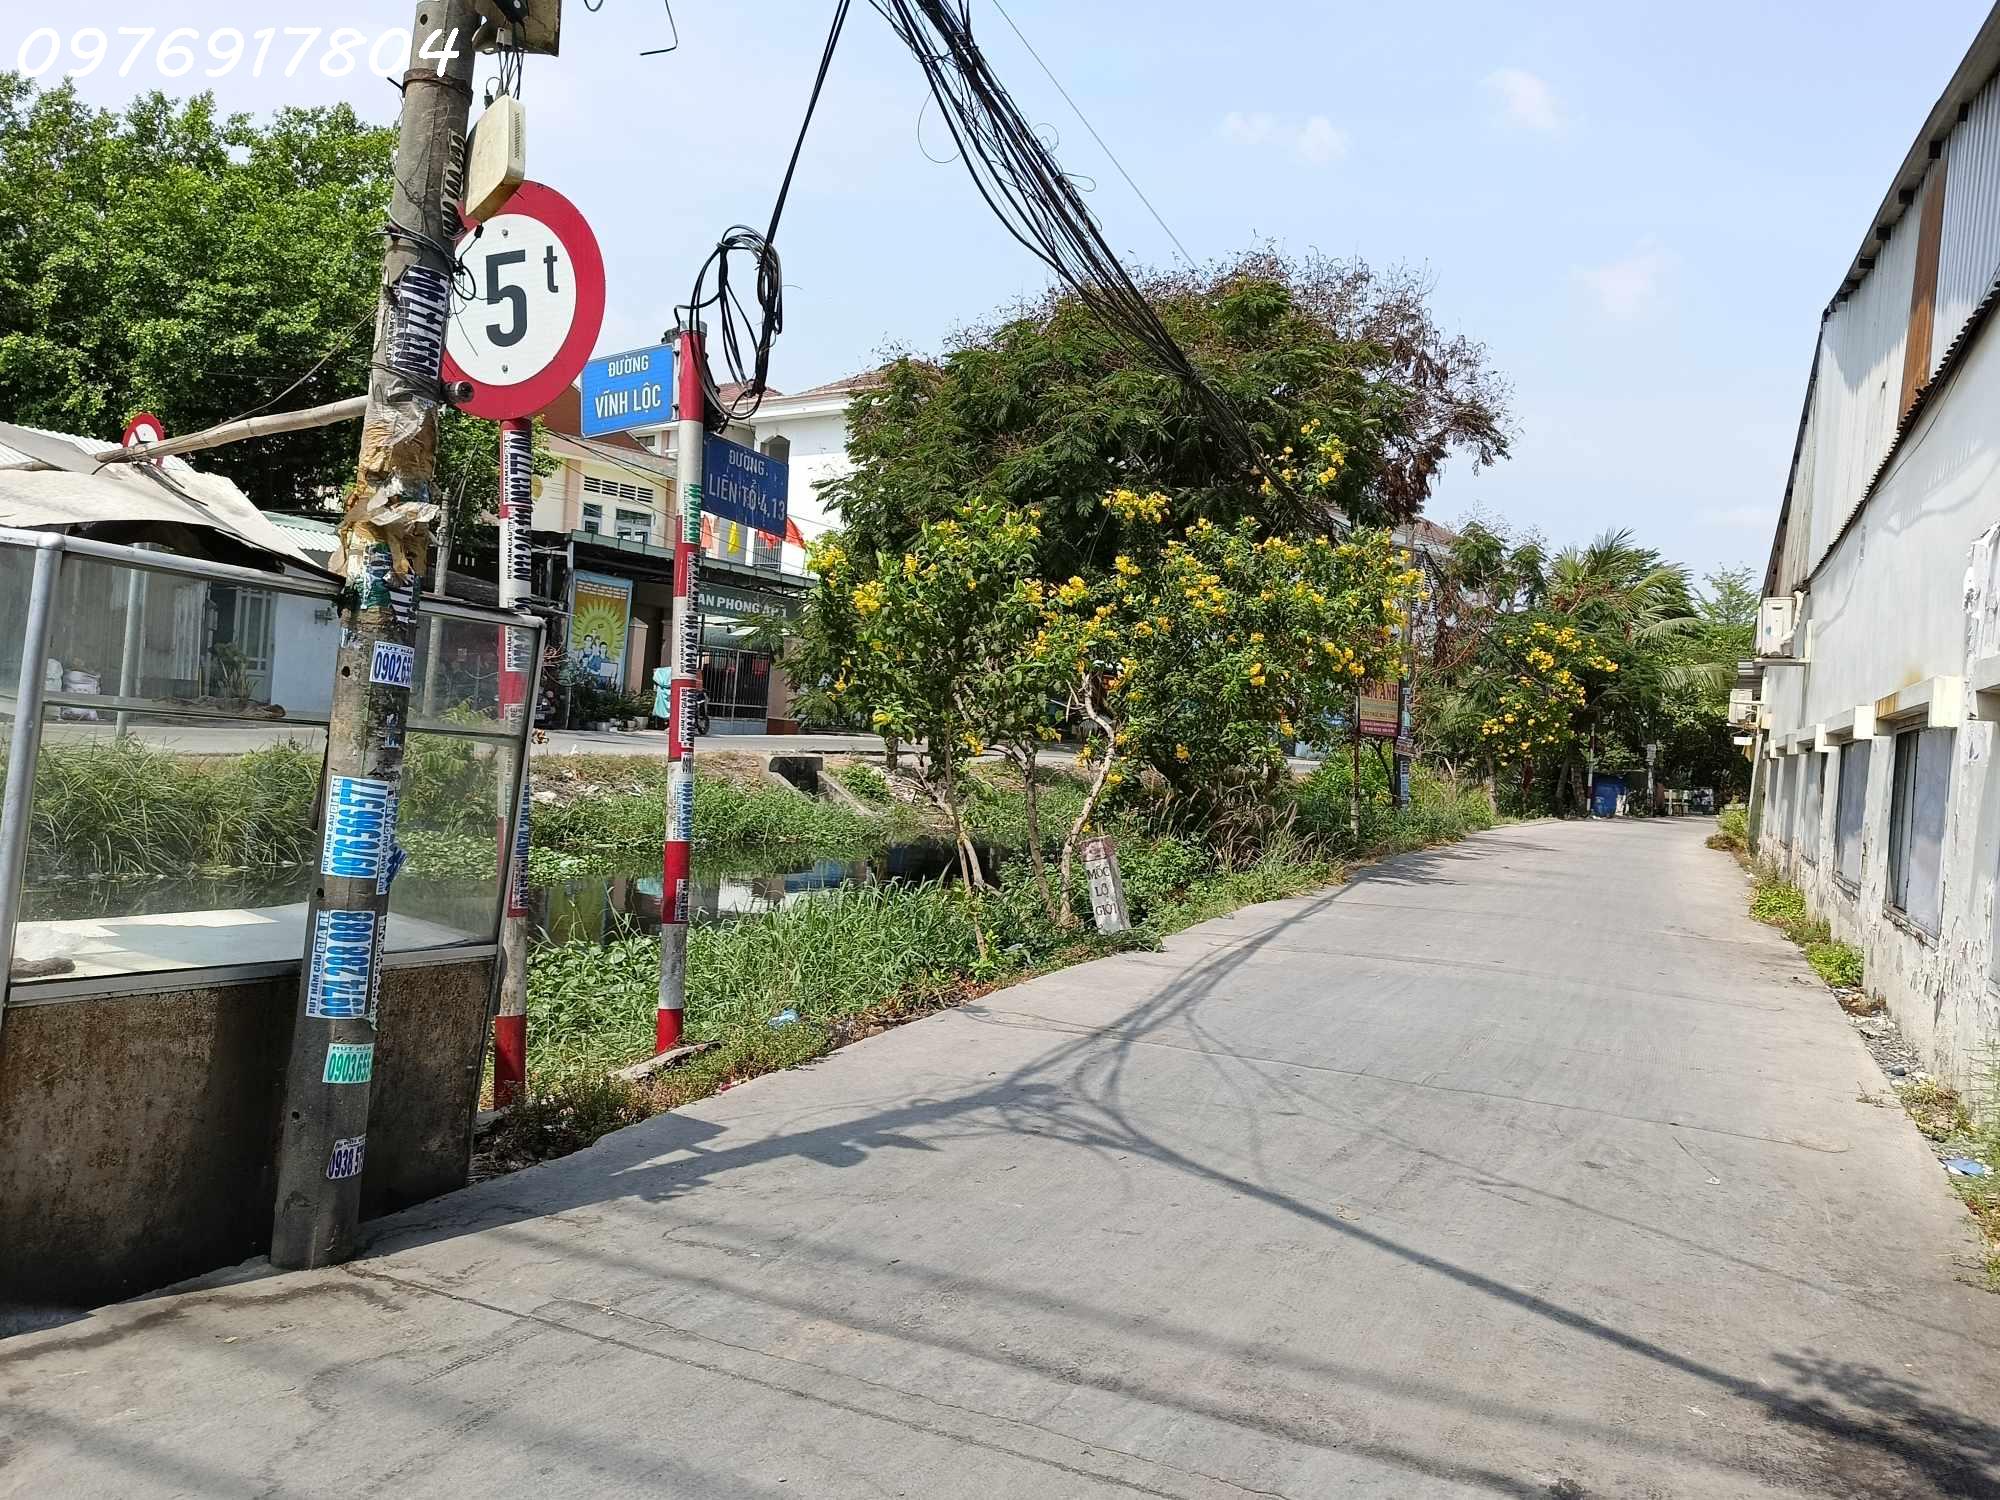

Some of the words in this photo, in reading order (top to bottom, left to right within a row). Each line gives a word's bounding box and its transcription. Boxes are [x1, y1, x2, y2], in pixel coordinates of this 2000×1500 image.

[485, 249, 528, 347] 5
[543, 245, 559, 293] t
[608, 355, 649, 377] ĐƯỜNG
[595, 389, 628, 418] VĨNH
[633, 383, 661, 413] LỘC
[729, 450, 765, 476] ĐƯỜNG
[708, 473, 737, 504] LIÊN
[331, 778, 387, 876] 0976.566.577
[319, 912, 373, 1017] 0974.288.088
